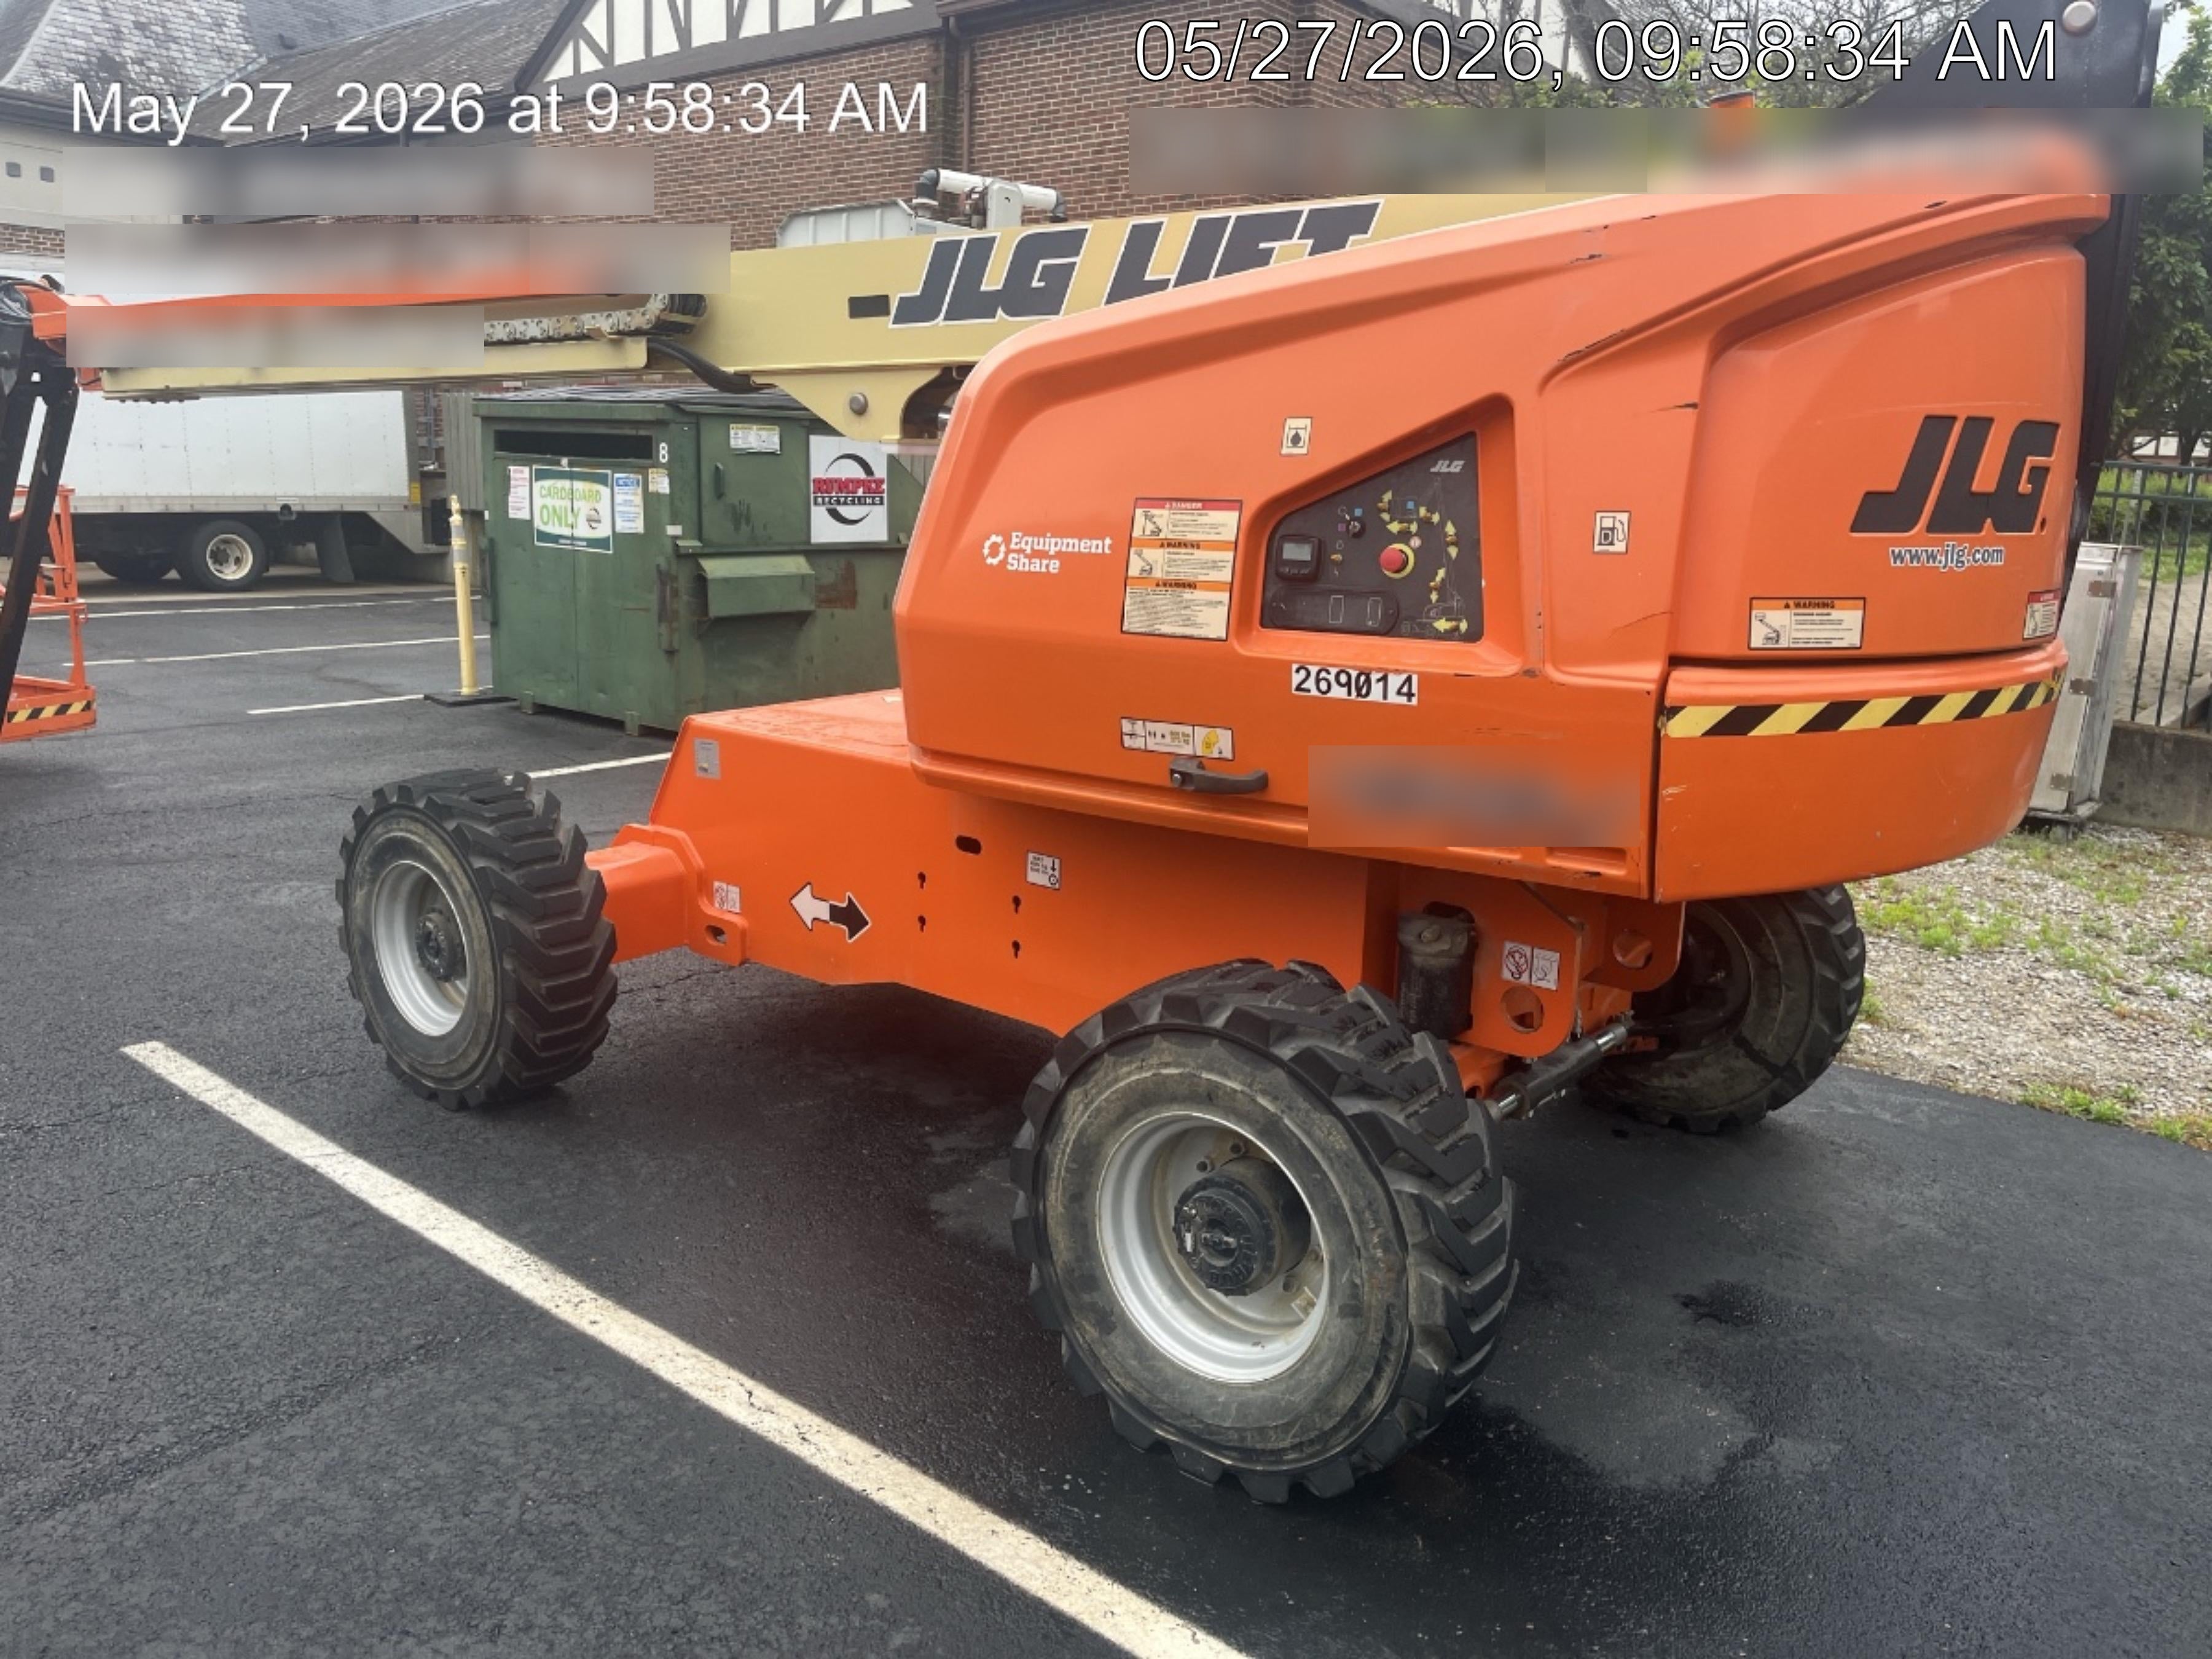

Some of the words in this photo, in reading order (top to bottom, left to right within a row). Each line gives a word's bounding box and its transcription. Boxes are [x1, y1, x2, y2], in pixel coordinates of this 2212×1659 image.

[888, 224, 1092, 328] JLG
[1102, 198, 1385, 307] LIFT
[659, 442, 668, 463] 8
[1430, 460, 1465, 473] JLG
[1849, 415, 2061, 535] JLG
[539, 485, 602, 504] CARDBOARD
[539, 504, 581, 530] ONLY
[1010, 532, 1112, 555] Equipment
[1006, 552, 1060, 573] Share
[1890, 541, 2004, 571] www.jlg.com
